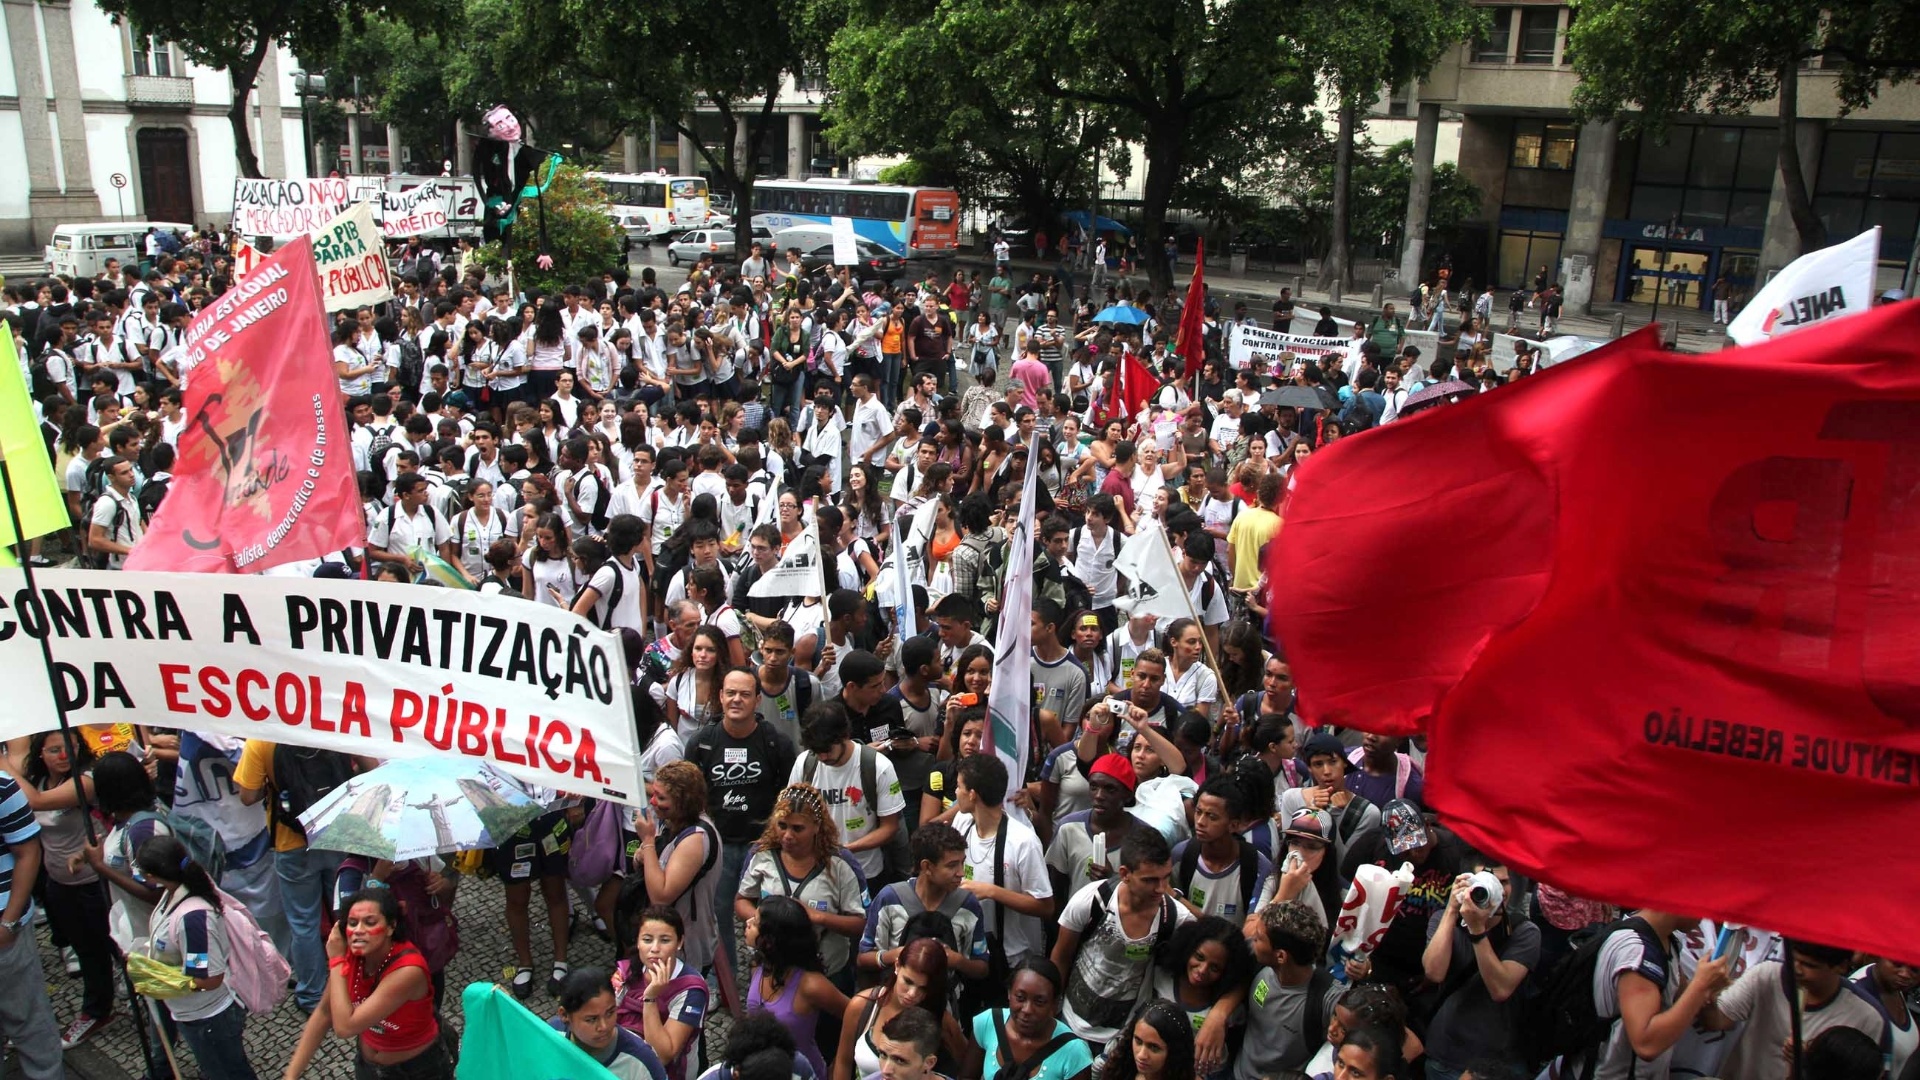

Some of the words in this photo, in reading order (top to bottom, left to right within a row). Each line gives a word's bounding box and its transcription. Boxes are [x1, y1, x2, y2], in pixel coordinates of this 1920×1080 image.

[309, 178, 345, 205] NÃO
[246, 205, 332, 234] MERCADORIA
[333, 221, 359, 244] PIB
[384, 211, 447, 237] DIREITO
[313, 241, 355, 265] PARA
[357, 238, 367, 254] A
[329, 254, 386, 297] PÚBLICA
[215, 262, 289, 321] ESTADUAL
[187, 346, 207, 370] RIO
[203, 329, 232, 352] DE
[229, 287, 288, 333] JANEIRO
[1252, 330, 1291, 342] FRENTE
[1293, 337, 1350, 348] NACIONAL
[1242, 339, 1277, 350] CONTRA
[312, 392, 327, 446] massas
[309, 448, 326, 467] de
[308, 468, 320, 479] e
[0, 588, 193, 642] CONTRA
[223, 593, 262, 646] A
[285, 595, 613, 705] PRIVATIZAÇÃO
[52, 661, 136, 712] DA
[158, 663, 371, 738] ESCOLA
[390, 683, 611, 785] PÚBLICA.
